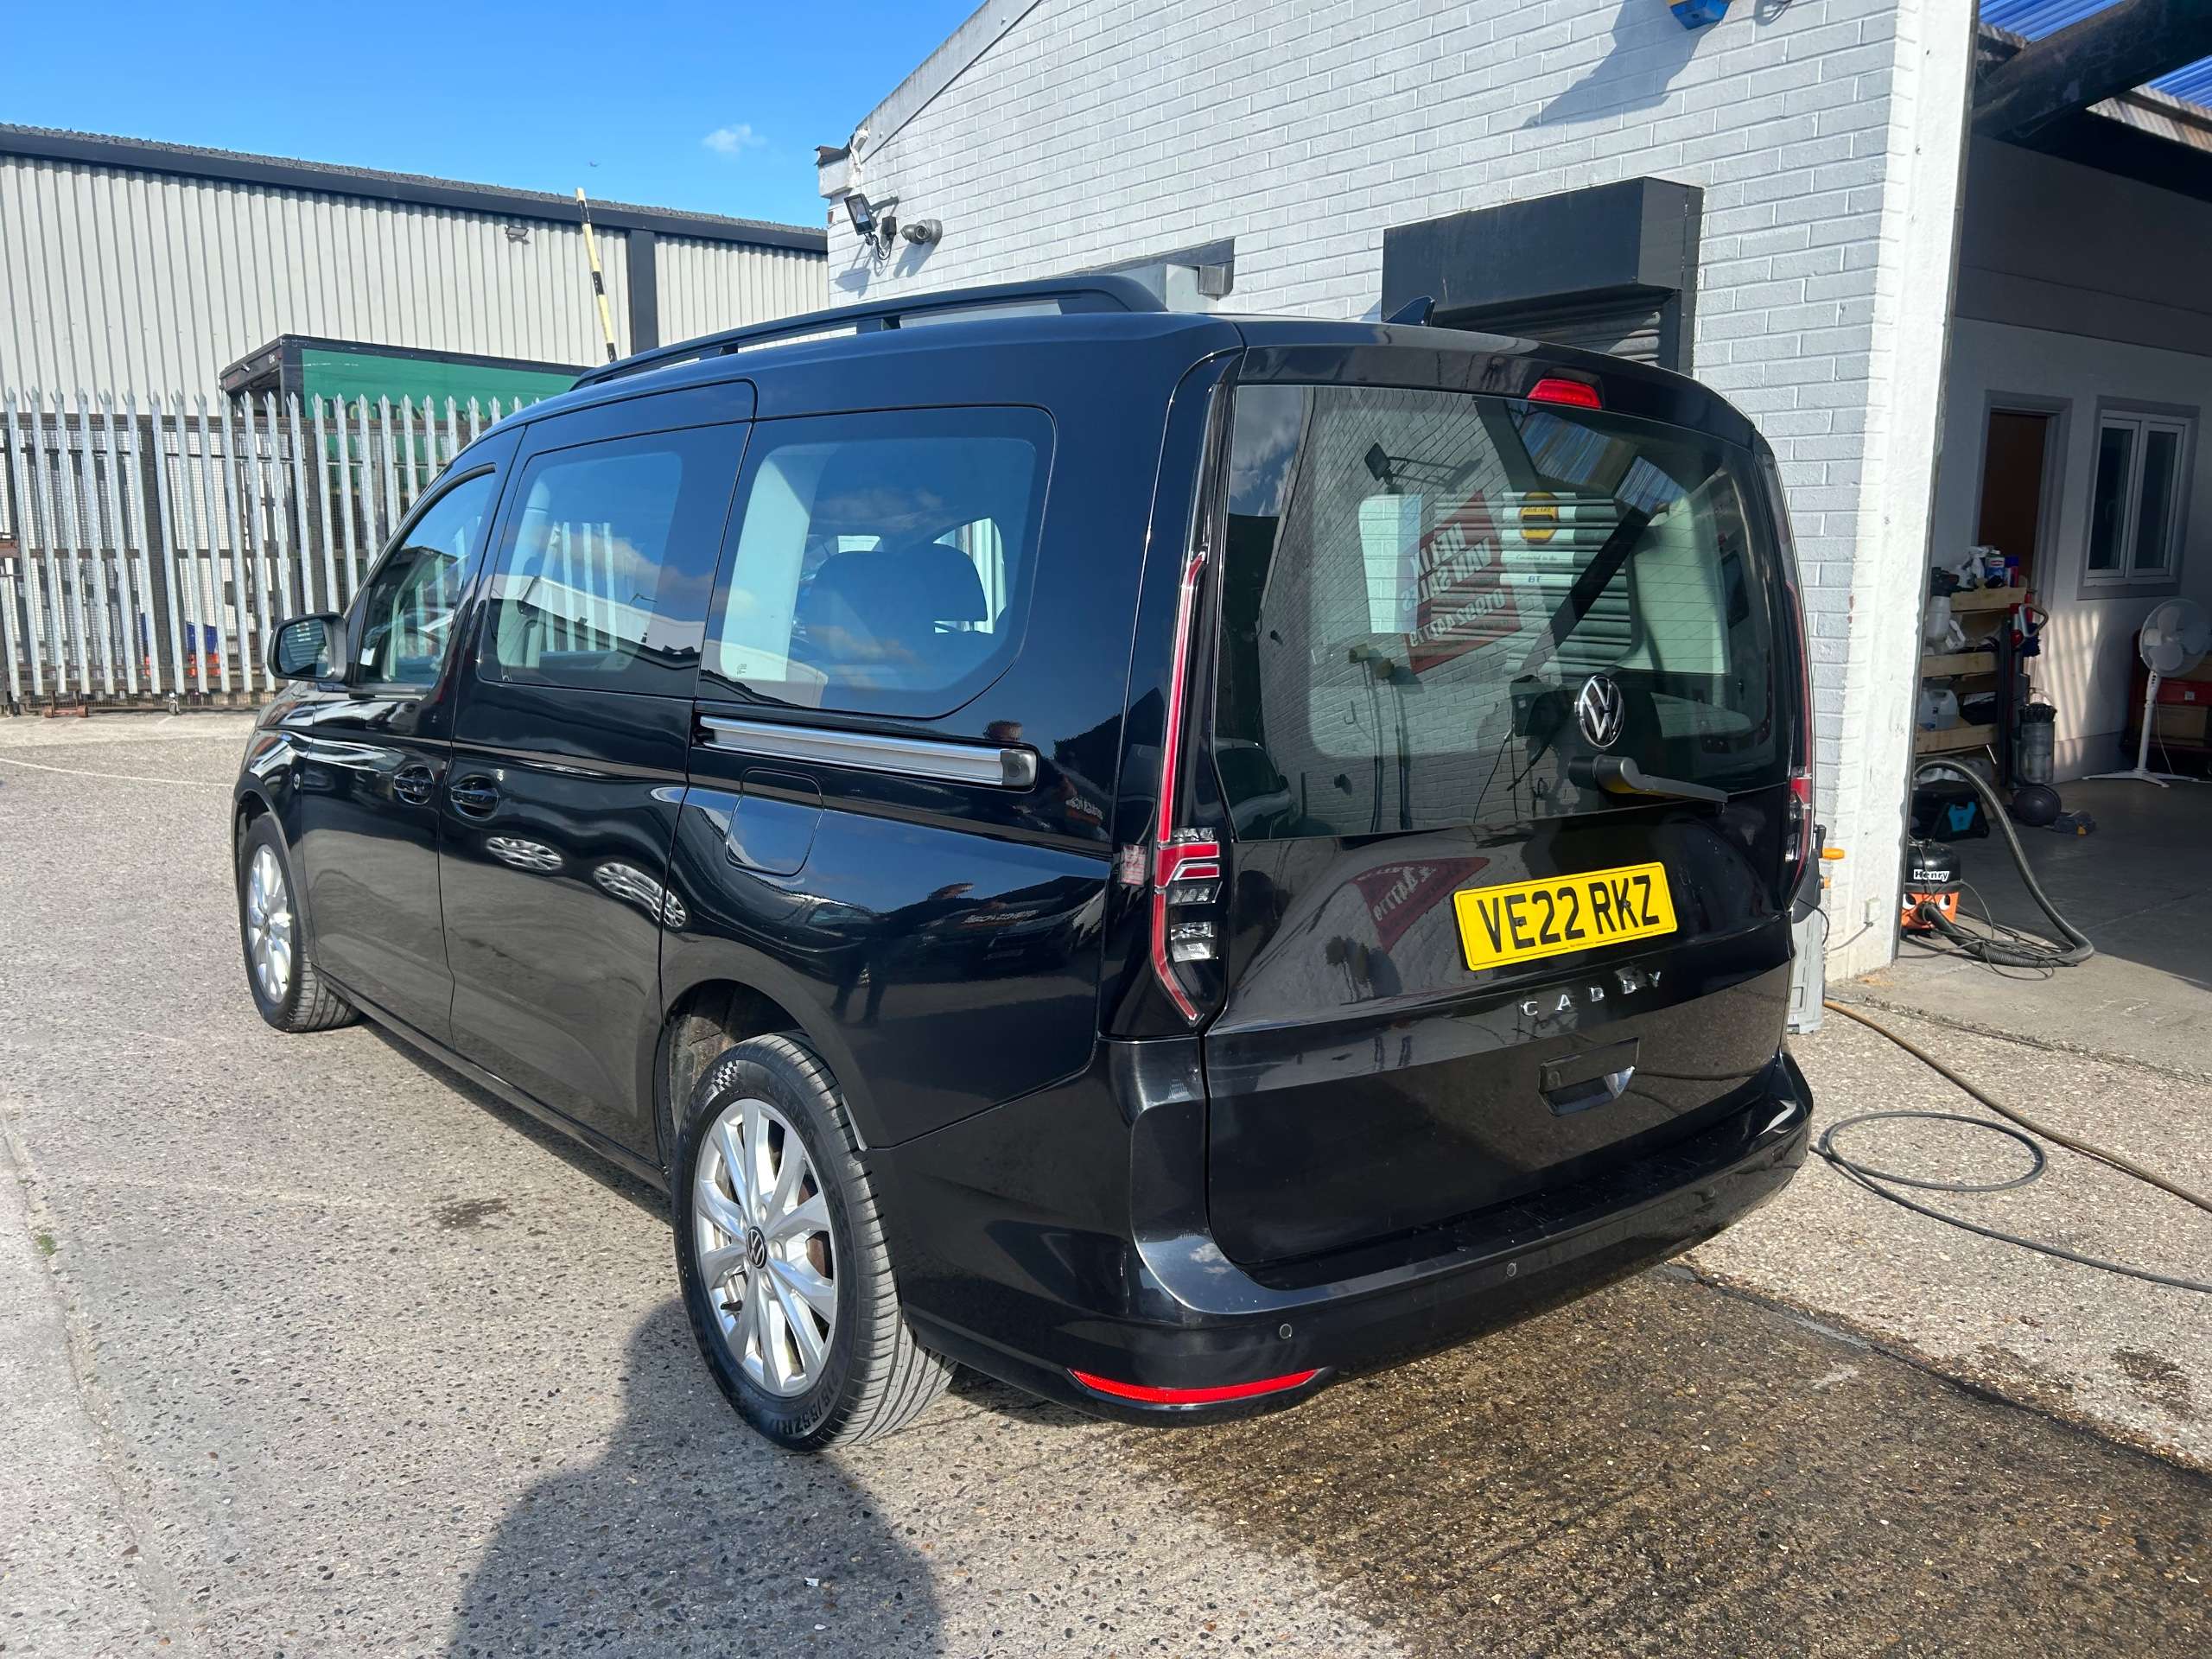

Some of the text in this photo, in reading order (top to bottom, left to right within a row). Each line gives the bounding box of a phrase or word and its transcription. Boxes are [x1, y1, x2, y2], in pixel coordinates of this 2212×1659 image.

[1913, 868, 1950, 882] Henry
[1477, 885, 1586, 953] VE22
[1587, 874, 1660, 935] RKZ
